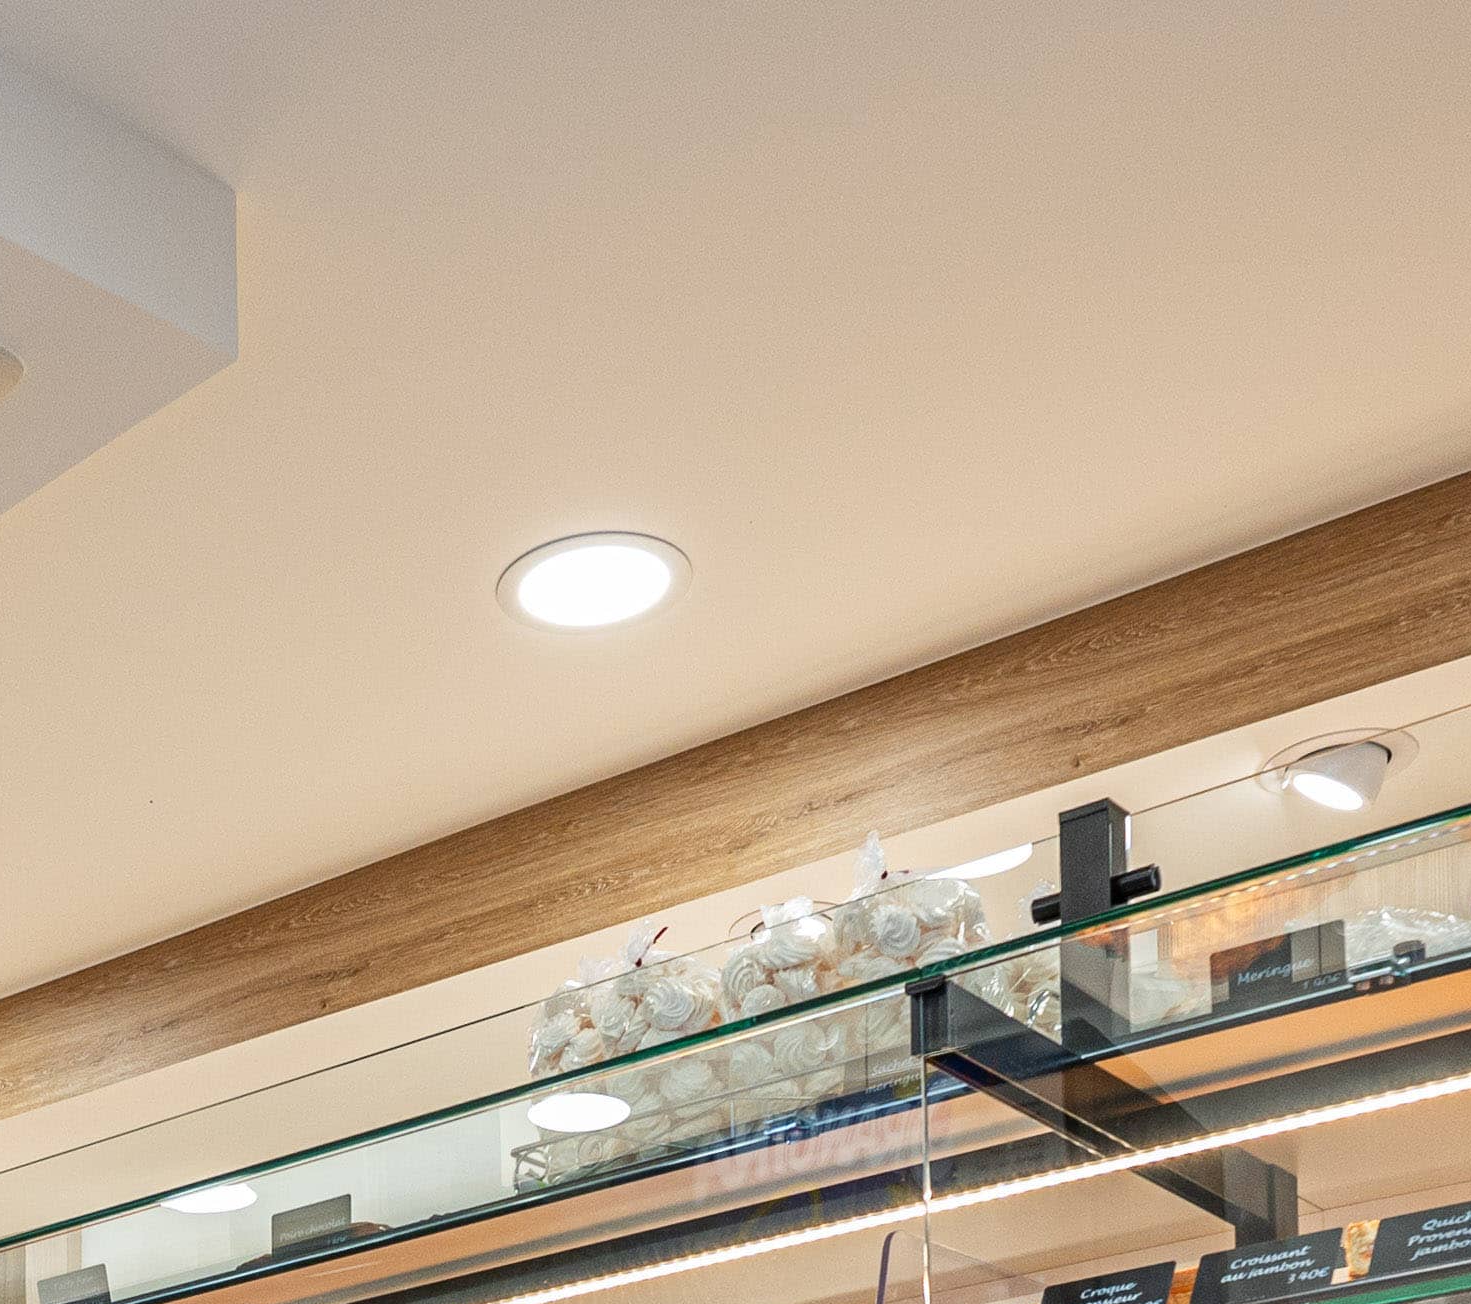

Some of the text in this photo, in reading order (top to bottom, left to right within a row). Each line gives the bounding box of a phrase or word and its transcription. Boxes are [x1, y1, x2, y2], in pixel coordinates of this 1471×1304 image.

[1237, 959, 1314, 985] Meringue
[1220, 1257, 1316, 1285] au jambon
[1230, 1245, 1312, 1271] Croissant
[1080, 1281, 1138, 1301] Croque
